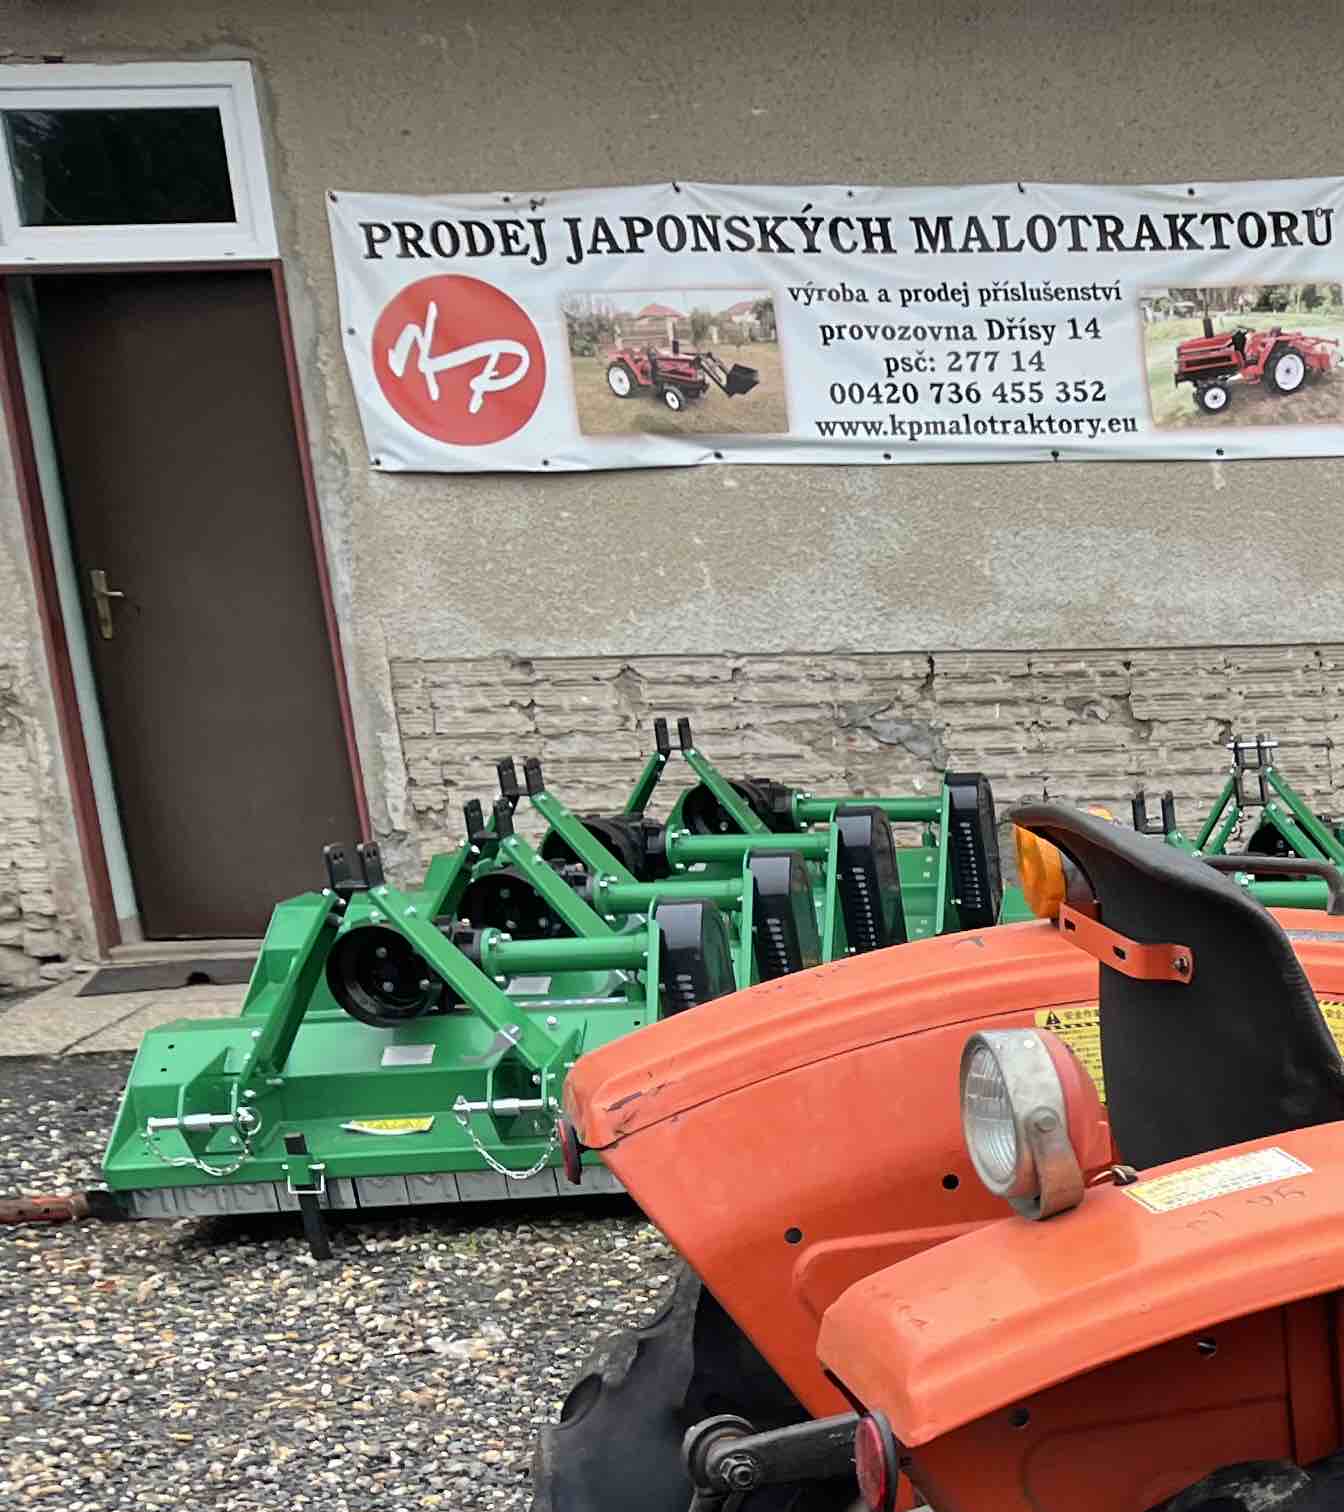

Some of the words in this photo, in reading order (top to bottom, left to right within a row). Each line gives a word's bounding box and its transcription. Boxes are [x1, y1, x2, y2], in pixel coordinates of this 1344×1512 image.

[359, 217, 548, 266] PRODEJ
[565, 204, 897, 266] JAPONSKÝCH
[788, 283, 868, 308] výroba
[877, 287, 891, 303] a
[899, 281, 970, 308] prodej
[978, 280, 1122, 306] příslušenství
[821, 321, 976, 346] provozovna
[984, 317, 1056, 345] Dřísy
[1067, 318, 1101, 340] 14
[884, 350, 936, 378] psč:
[947, 352, 999, 373] 277
[1011, 351, 1045, 372] 14
[830, 382, 919, 405] 00420
[931, 382, 981, 404] 736
[992, 382, 1044, 403] 455
[1055, 380, 1107, 402] 352
[816, 411, 1138, 441] www.kpmalotraktory.eu
